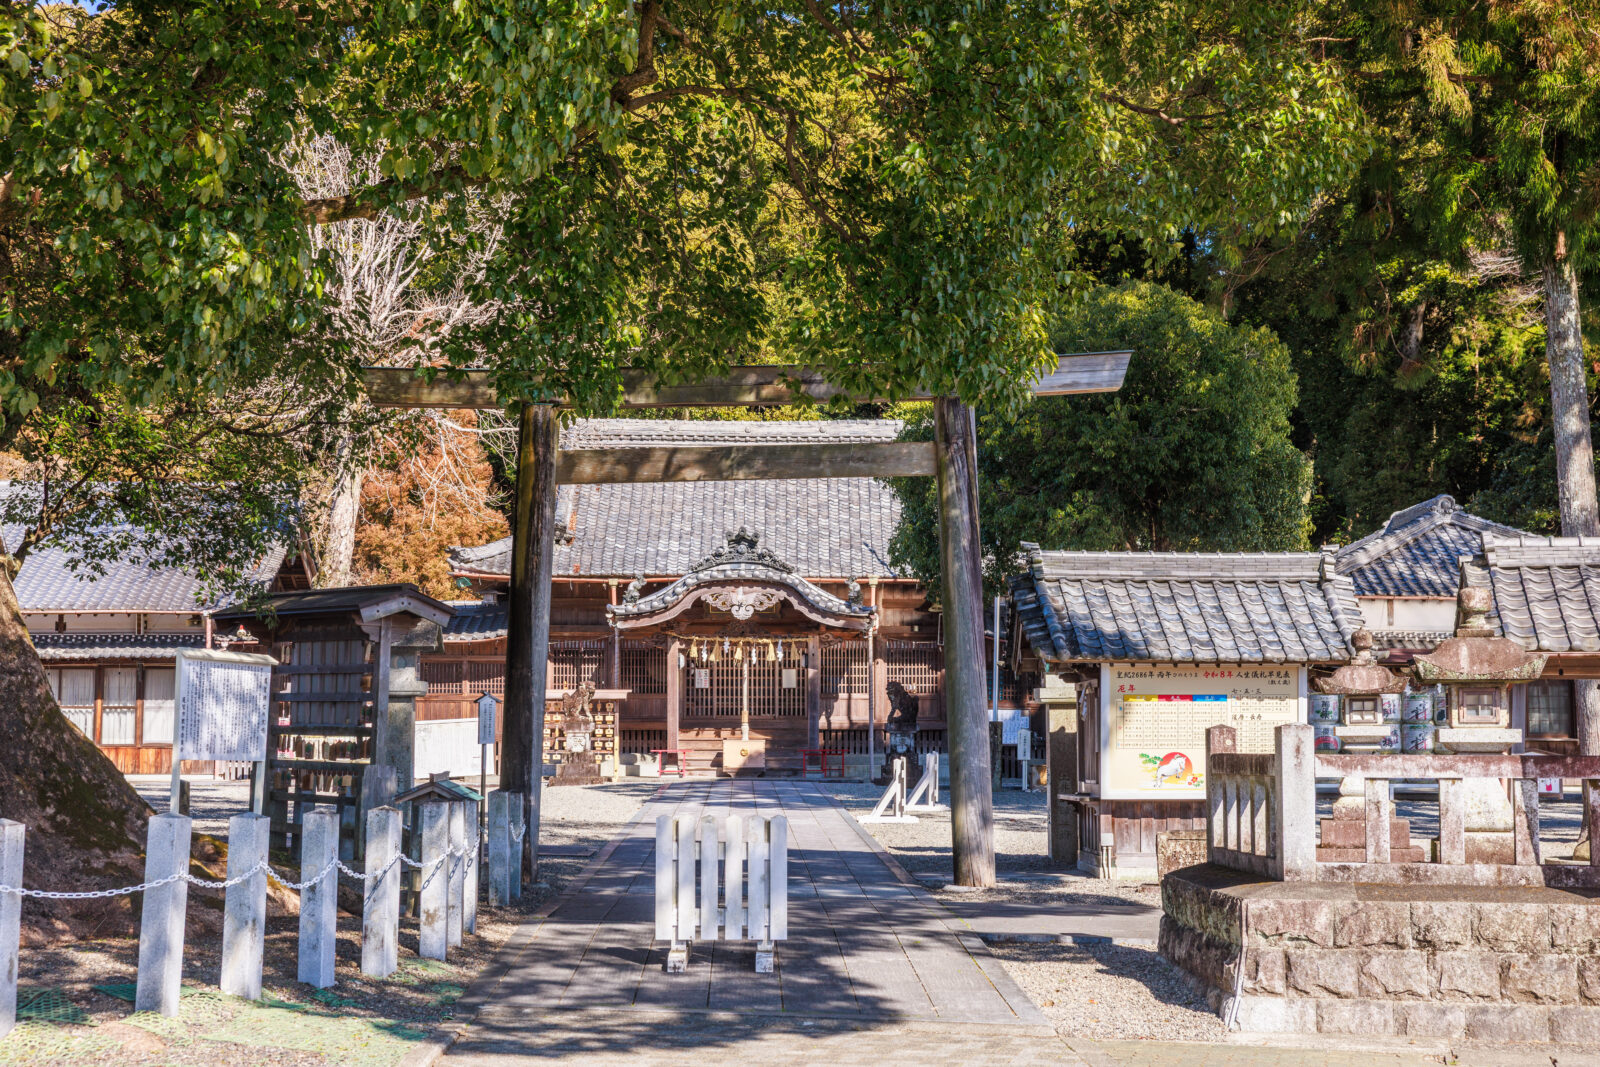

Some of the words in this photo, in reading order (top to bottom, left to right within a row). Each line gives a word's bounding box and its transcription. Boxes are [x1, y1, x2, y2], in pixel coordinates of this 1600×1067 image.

[1203, 670, 1233, 679] 令和8年
[1117, 684, 1136, 693] 厄年
